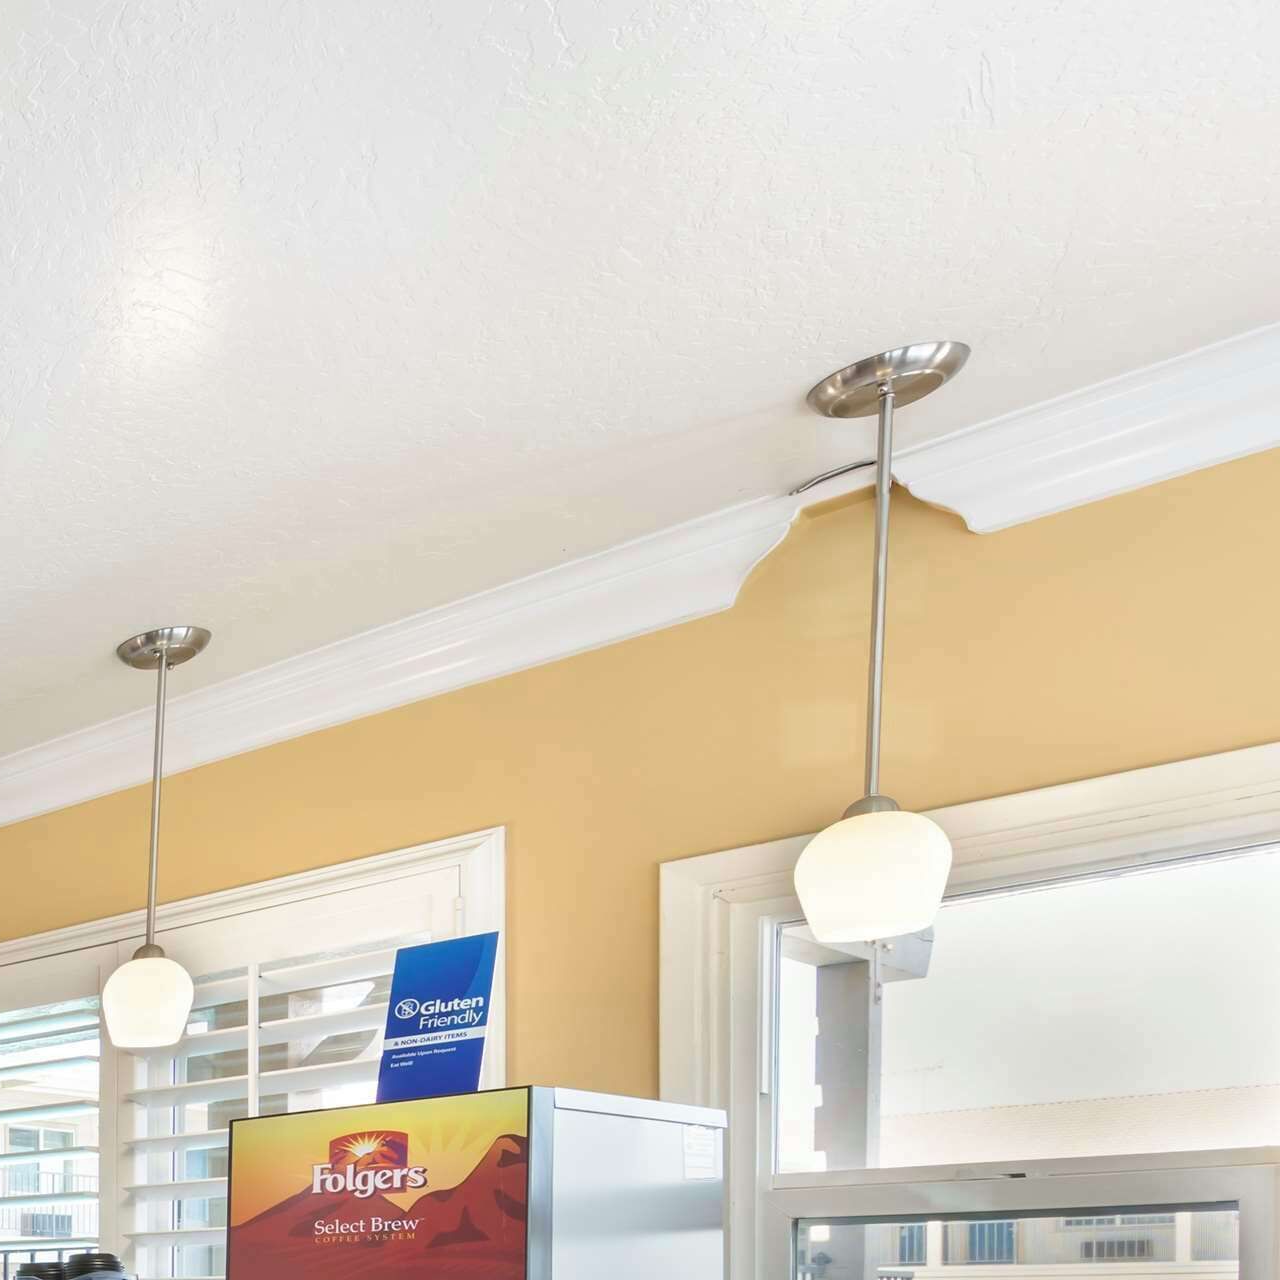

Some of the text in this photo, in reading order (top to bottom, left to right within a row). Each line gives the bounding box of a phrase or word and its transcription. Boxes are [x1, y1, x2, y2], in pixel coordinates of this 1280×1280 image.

[420, 996, 483, 1015] Gluten
[419, 1010, 483, 1030] Friendly
[400, 1034, 443, 1047] NON-DAIRY
[444, 1031, 467, 1040] ITEMS
[312, 1163, 428, 1198] Folgers
[314, 1217, 419, 1235] Select Brew
[315, 1232, 415, 1243] COFFEE SYSTEM
